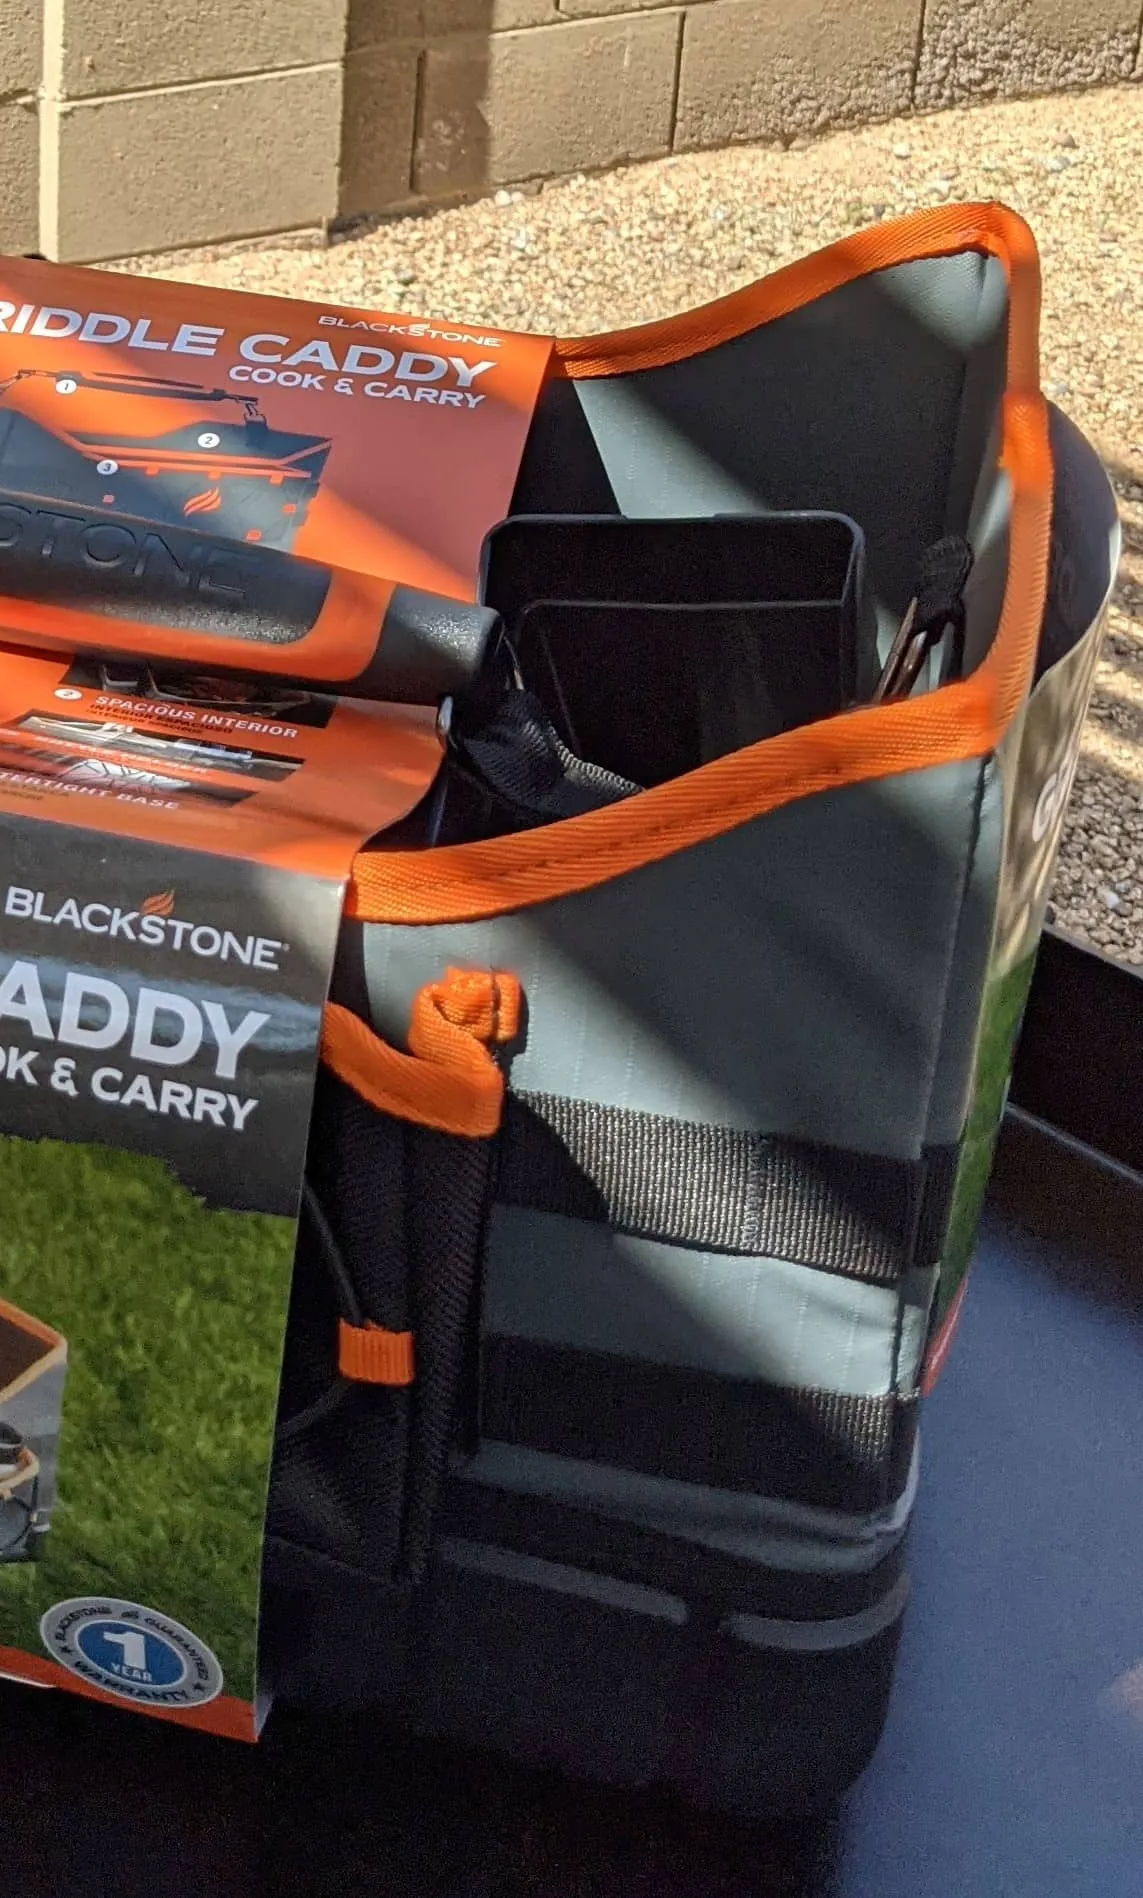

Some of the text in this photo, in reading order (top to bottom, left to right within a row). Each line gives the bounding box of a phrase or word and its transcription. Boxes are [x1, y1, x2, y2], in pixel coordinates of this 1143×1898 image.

[318, 315, 502, 347] BLACKSTONE
[239, 334, 497, 387] CADDY
[228, 366, 487, 409] COOK & CARRY
[95, 695, 196, 721] SPACIOUS
[201, 714, 298, 738] INTERIOR
[117, 792, 180, 810] BASE
[5, 886, 283, 970] BLACKSTONE
[50, 1056, 79, 1097] &
[91, 1067, 259, 1131] CARRY
[103, 1631, 146, 1670] 1
[111, 1662, 153, 1682] YEAR
